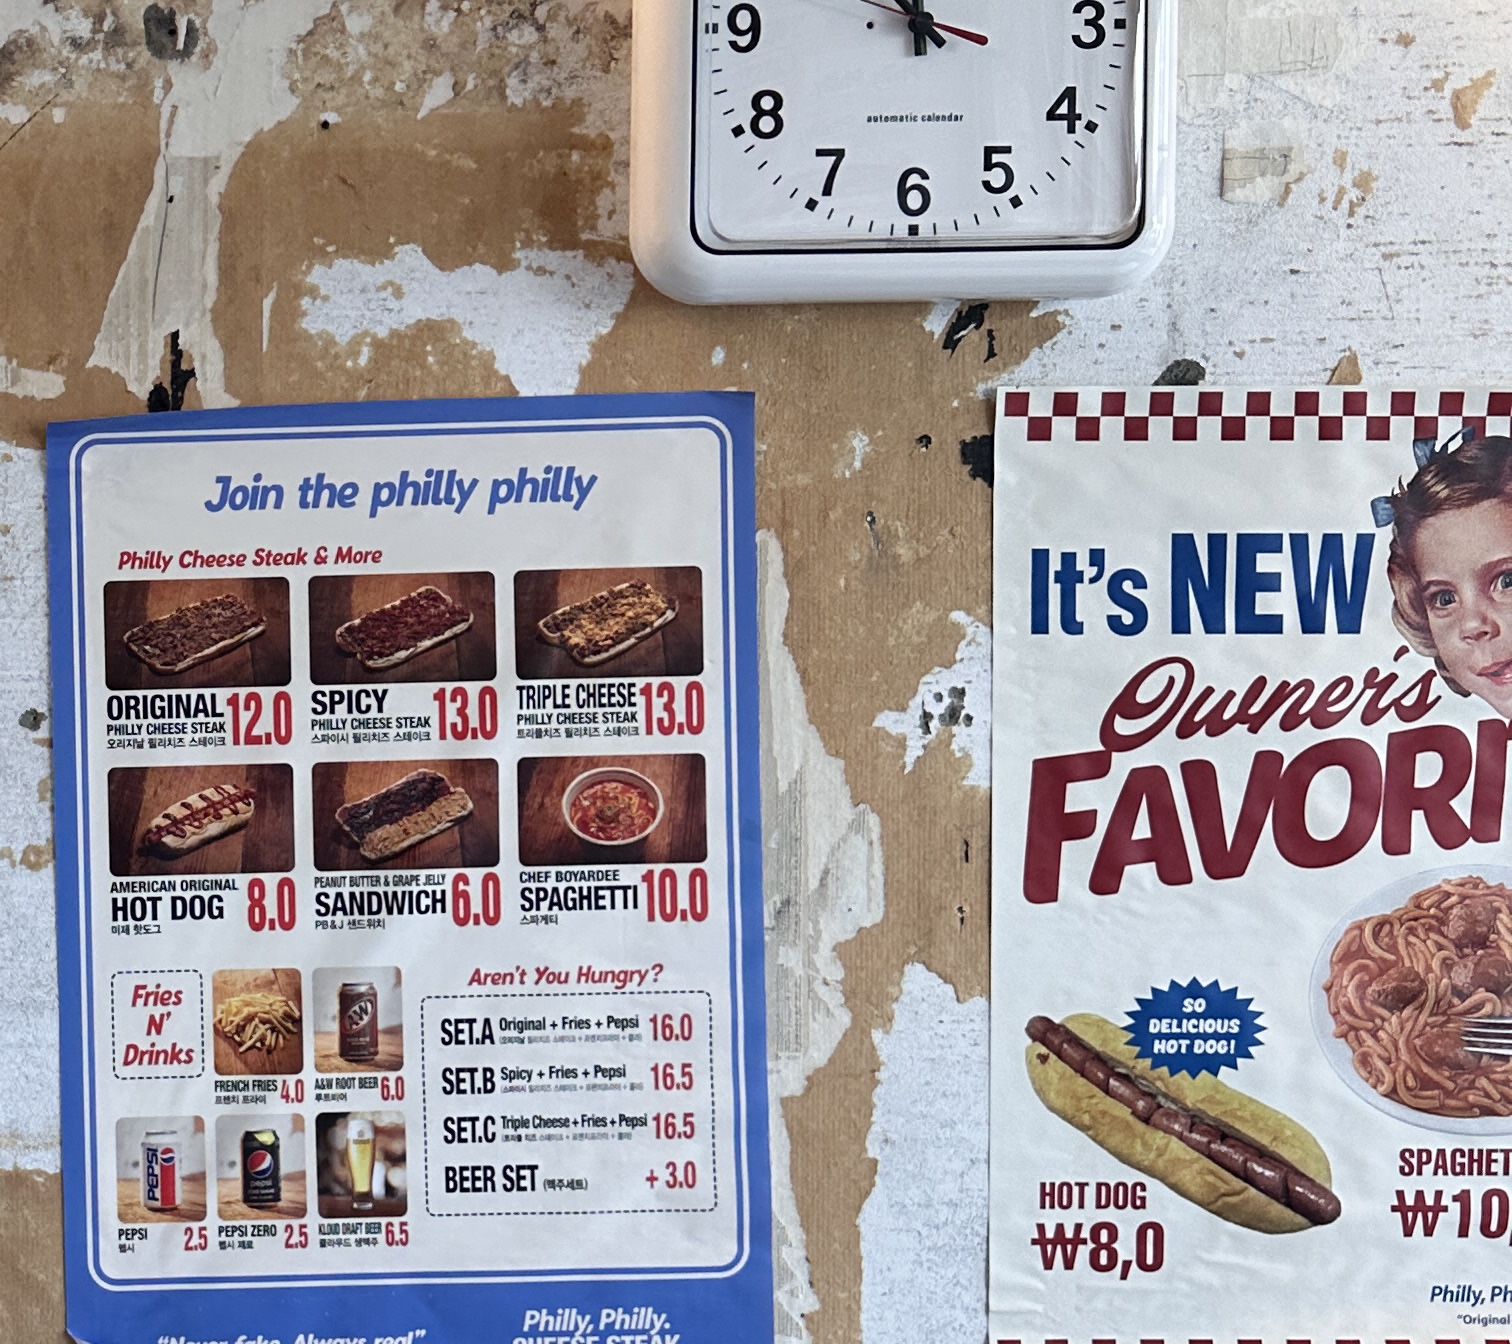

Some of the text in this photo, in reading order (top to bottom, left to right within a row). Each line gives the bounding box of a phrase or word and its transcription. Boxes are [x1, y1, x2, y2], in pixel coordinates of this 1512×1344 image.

[726, 3, 762, 53] 9
[1072, 0, 1106, 49] 3
[749, 89, 784, 139] 8
[867, 112, 963, 123] automatic calendar
[1046, 86, 1081, 135] 4
[815, 148, 846, 197] 7
[981, 145, 1015, 195] 5
[896, 166, 931, 216] 6
[204, 465, 597, 518] Join the philly philly
[118, 546, 383, 573] Philly Cheese Steak & More
[1170, 532, 1376, 635] NEW
[107, 693, 224, 721] ORIGINAL
[311, 688, 389, 715] SPICY
[516, 682, 637, 709] TRIPLE CHEESE
[639, 681, 705, 736] 13.0
[226, 691, 292, 746] 12.0
[311, 716, 431, 731] PHILLY CHEESE STEAK
[433, 686, 498, 741] 13.0
[517, 710, 638, 725] PHILLY CHEESE STEAK
[107, 720, 227, 737] PHILLY CHEESE STEAK
[107, 738, 144, 749] 오리지날
[1022, 718, 1512, 904] FAVORI
[110, 878, 239, 894] AMERICAN ORIGINAL
[314, 873, 446, 888] PEANUT BUTTER & GRAPE JELLY
[519, 869, 619, 884] CHEF BOYARDEE
[111, 894, 224, 922] HOT DOG
[248, 877, 296, 932] 8.0
[315, 889, 446, 917] SANDWICH
[451, 872, 501, 927] 6.0
[520, 885, 638, 912] SPAGHETTI
[641, 867, 708, 923] 10.0
[133, 923, 161, 935] 핫도그
[468, 963, 663, 990] Aren't You Hungry?
[131, 983, 183, 1007] Fries
[1181, 997, 1207, 1014] SO
[441, 1017, 496, 1046] SET.A
[499, 1016, 547, 1034] Original
[562, 1015, 592, 1031] Fries
[606, 1014, 640, 1032] Pepsi
[649, 1013, 693, 1042] 16.0
[1148, 1018, 1241, 1034] DELICIOUS
[122, 1042, 195, 1066] Drinks
[1152, 1038, 1236, 1055] HOT DOG!
[214, 1079, 278, 1093] FRENCH FRIES
[280, 1078, 304, 1103] 4.0
[314, 1076, 379, 1090] A&W ROOT BEER
[380, 1075, 404, 1101] 6.0
[441, 1066, 496, 1095] SET.B
[500, 1066, 533, 1083] Spicy
[548, 1064, 579, 1079] Fries
[593, 1063, 627, 1082] Pepsi
[650, 1062, 694, 1091] 16.5
[443, 1115, 497, 1144] SET.C
[500, 1114, 530, 1132] Triple
[532, 1115, 571, 1130] Cheese
[580, 1113, 608, 1128] Fries
[618, 1112, 648, 1130] Pepsi
[651, 1112, 695, 1141] 16.5
[146, 1147, 160, 1202] PEPSI
[1398, 1147, 1512, 1177] SPAGHET
[444, 1165, 497, 1194] BEER
[502, 1163, 539, 1192] SET
[665, 1160, 697, 1190] 3.0
[1039, 1181, 1147, 1210] HOT DOG
[118, 1228, 148, 1241] PEPSI
[184, 1226, 208, 1252] 2.5
[218, 1224, 277, 1237] PEPSI ZERO
[284, 1223, 309, 1249] 2.5
[342, 1222, 363, 1235] DRAFT
[385, 1221, 409, 1247] 6.5
[1030, 1221, 1165, 1281] ₩8,0
[1430, 1284, 1486, 1307] Philly,
[523, 1306, 672, 1337] Philly, Philly.
